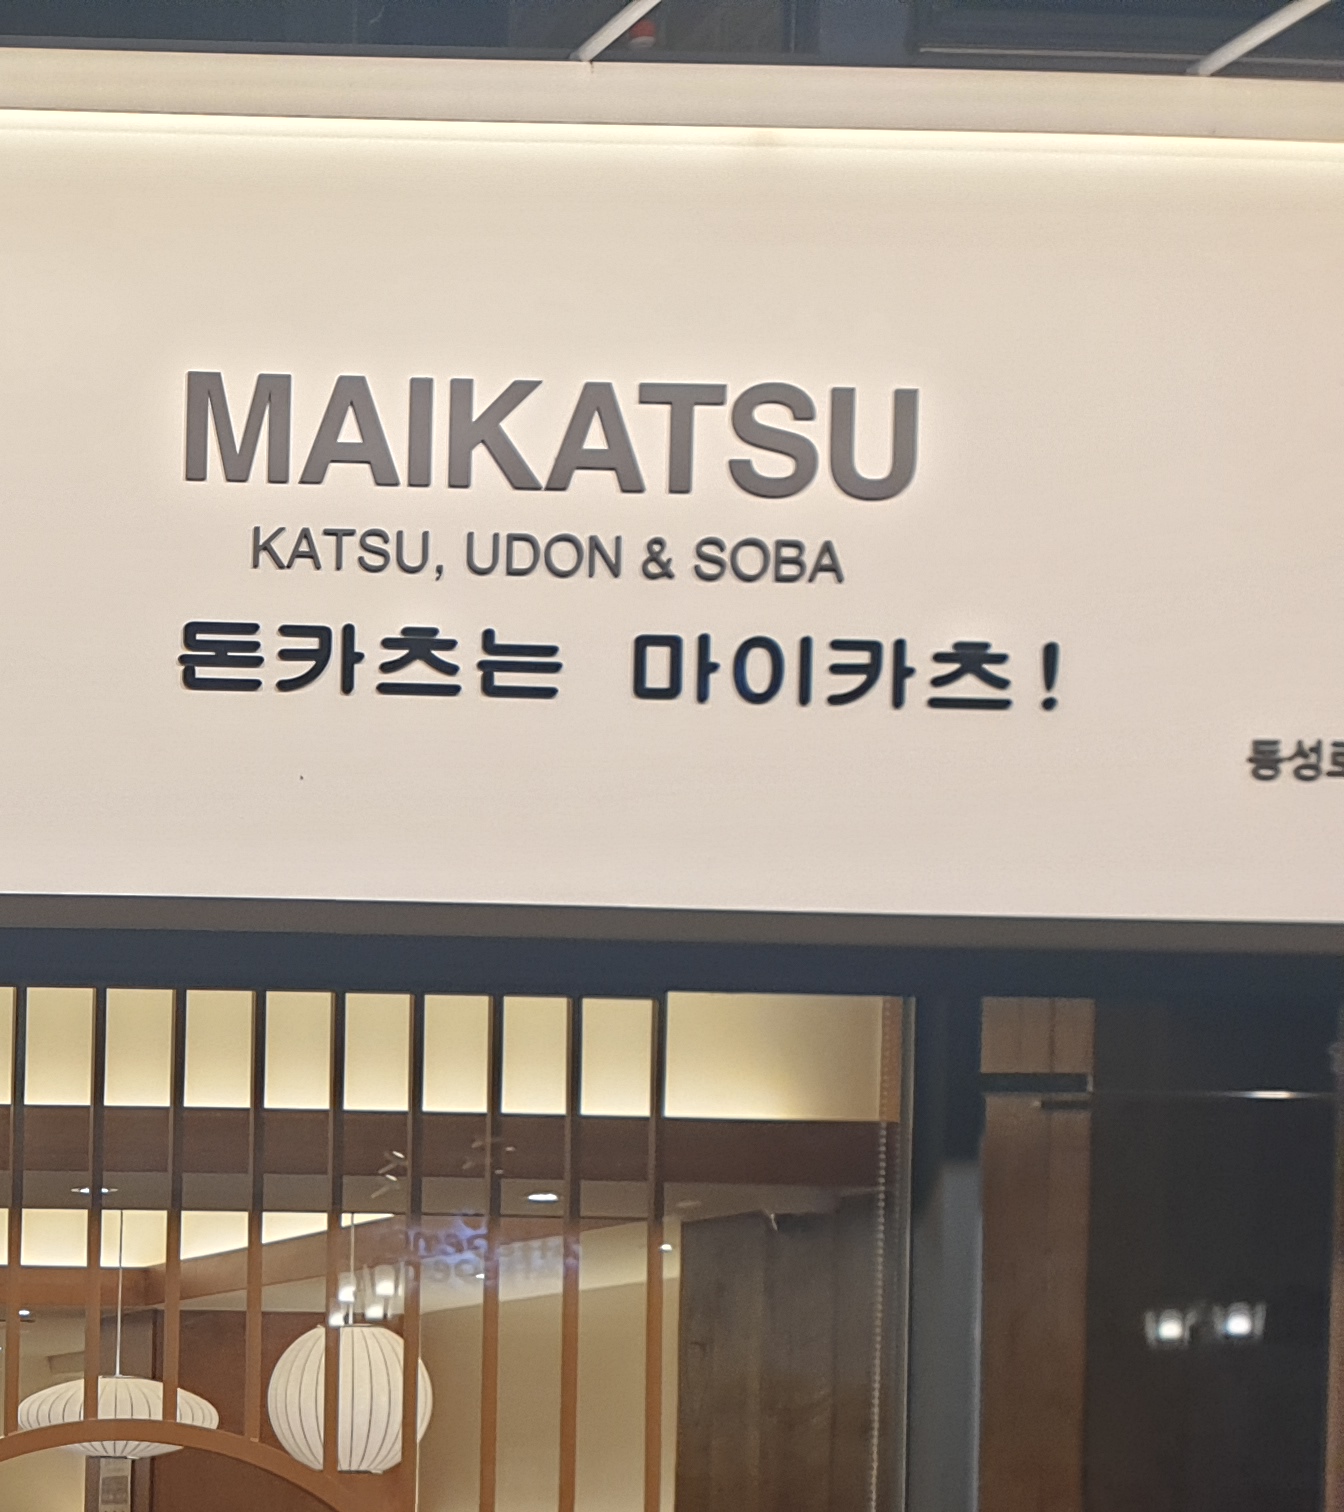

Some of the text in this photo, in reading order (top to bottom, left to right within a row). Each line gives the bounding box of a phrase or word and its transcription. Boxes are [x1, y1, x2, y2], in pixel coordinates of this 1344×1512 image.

[184, 368, 921, 501] MAIKATSU
[249, 525, 846, 585] KATSU, UDON & SOBA
[177, 619, 563, 701] 돈카츠는
